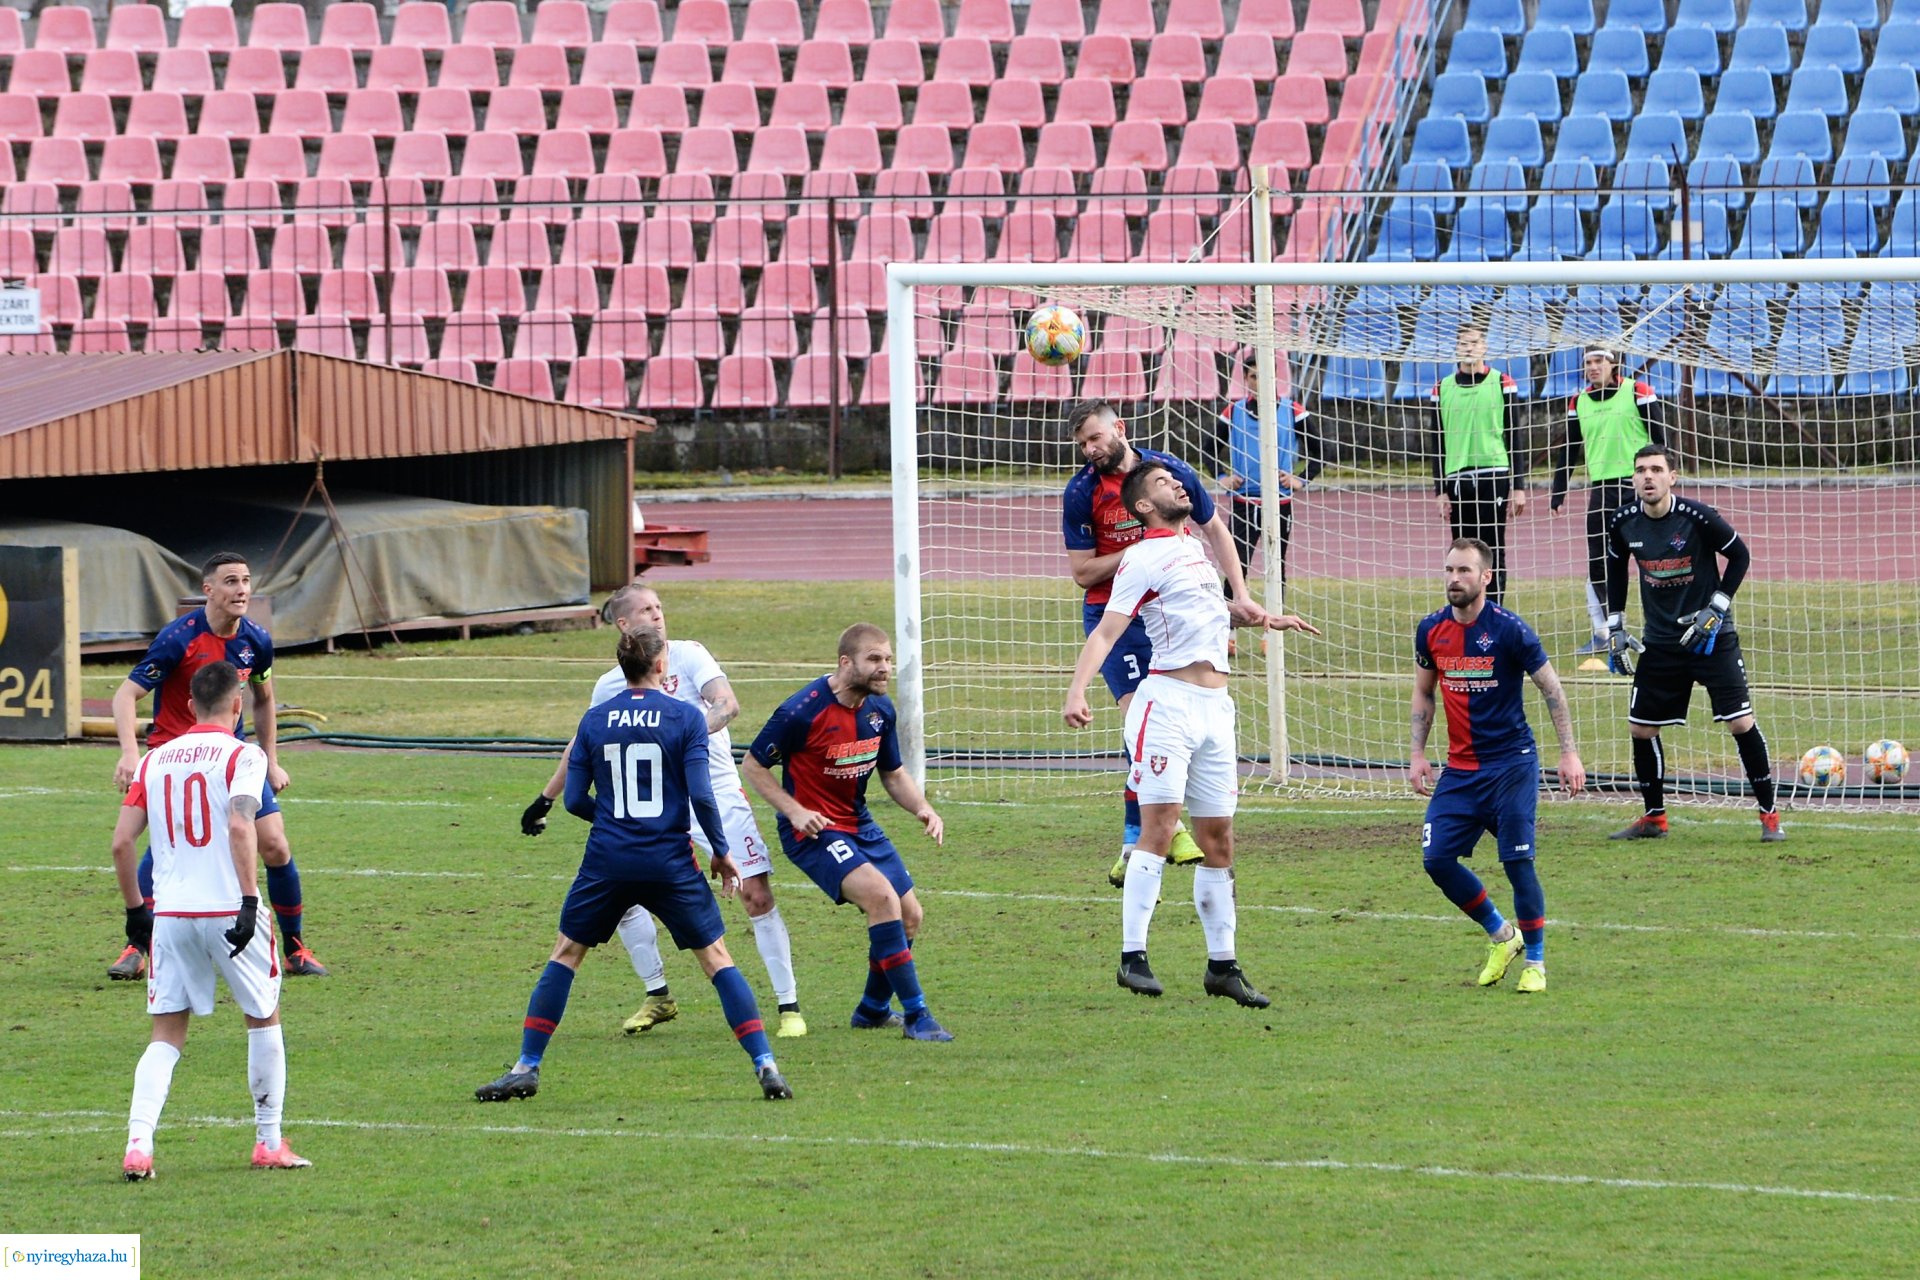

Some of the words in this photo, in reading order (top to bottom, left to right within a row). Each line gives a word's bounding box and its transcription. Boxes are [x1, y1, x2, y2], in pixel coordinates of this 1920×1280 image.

[1123, 654, 1141, 680] 3
[0, 667, 54, 718] 24
[607, 709, 662, 728] PAKU
[158, 742, 223, 766] HARSÁNYI
[603, 742, 664, 819] 10
[164, 771, 212, 849] 10
[744, 836, 758, 857] 2
[826, 839, 854, 864] 15
